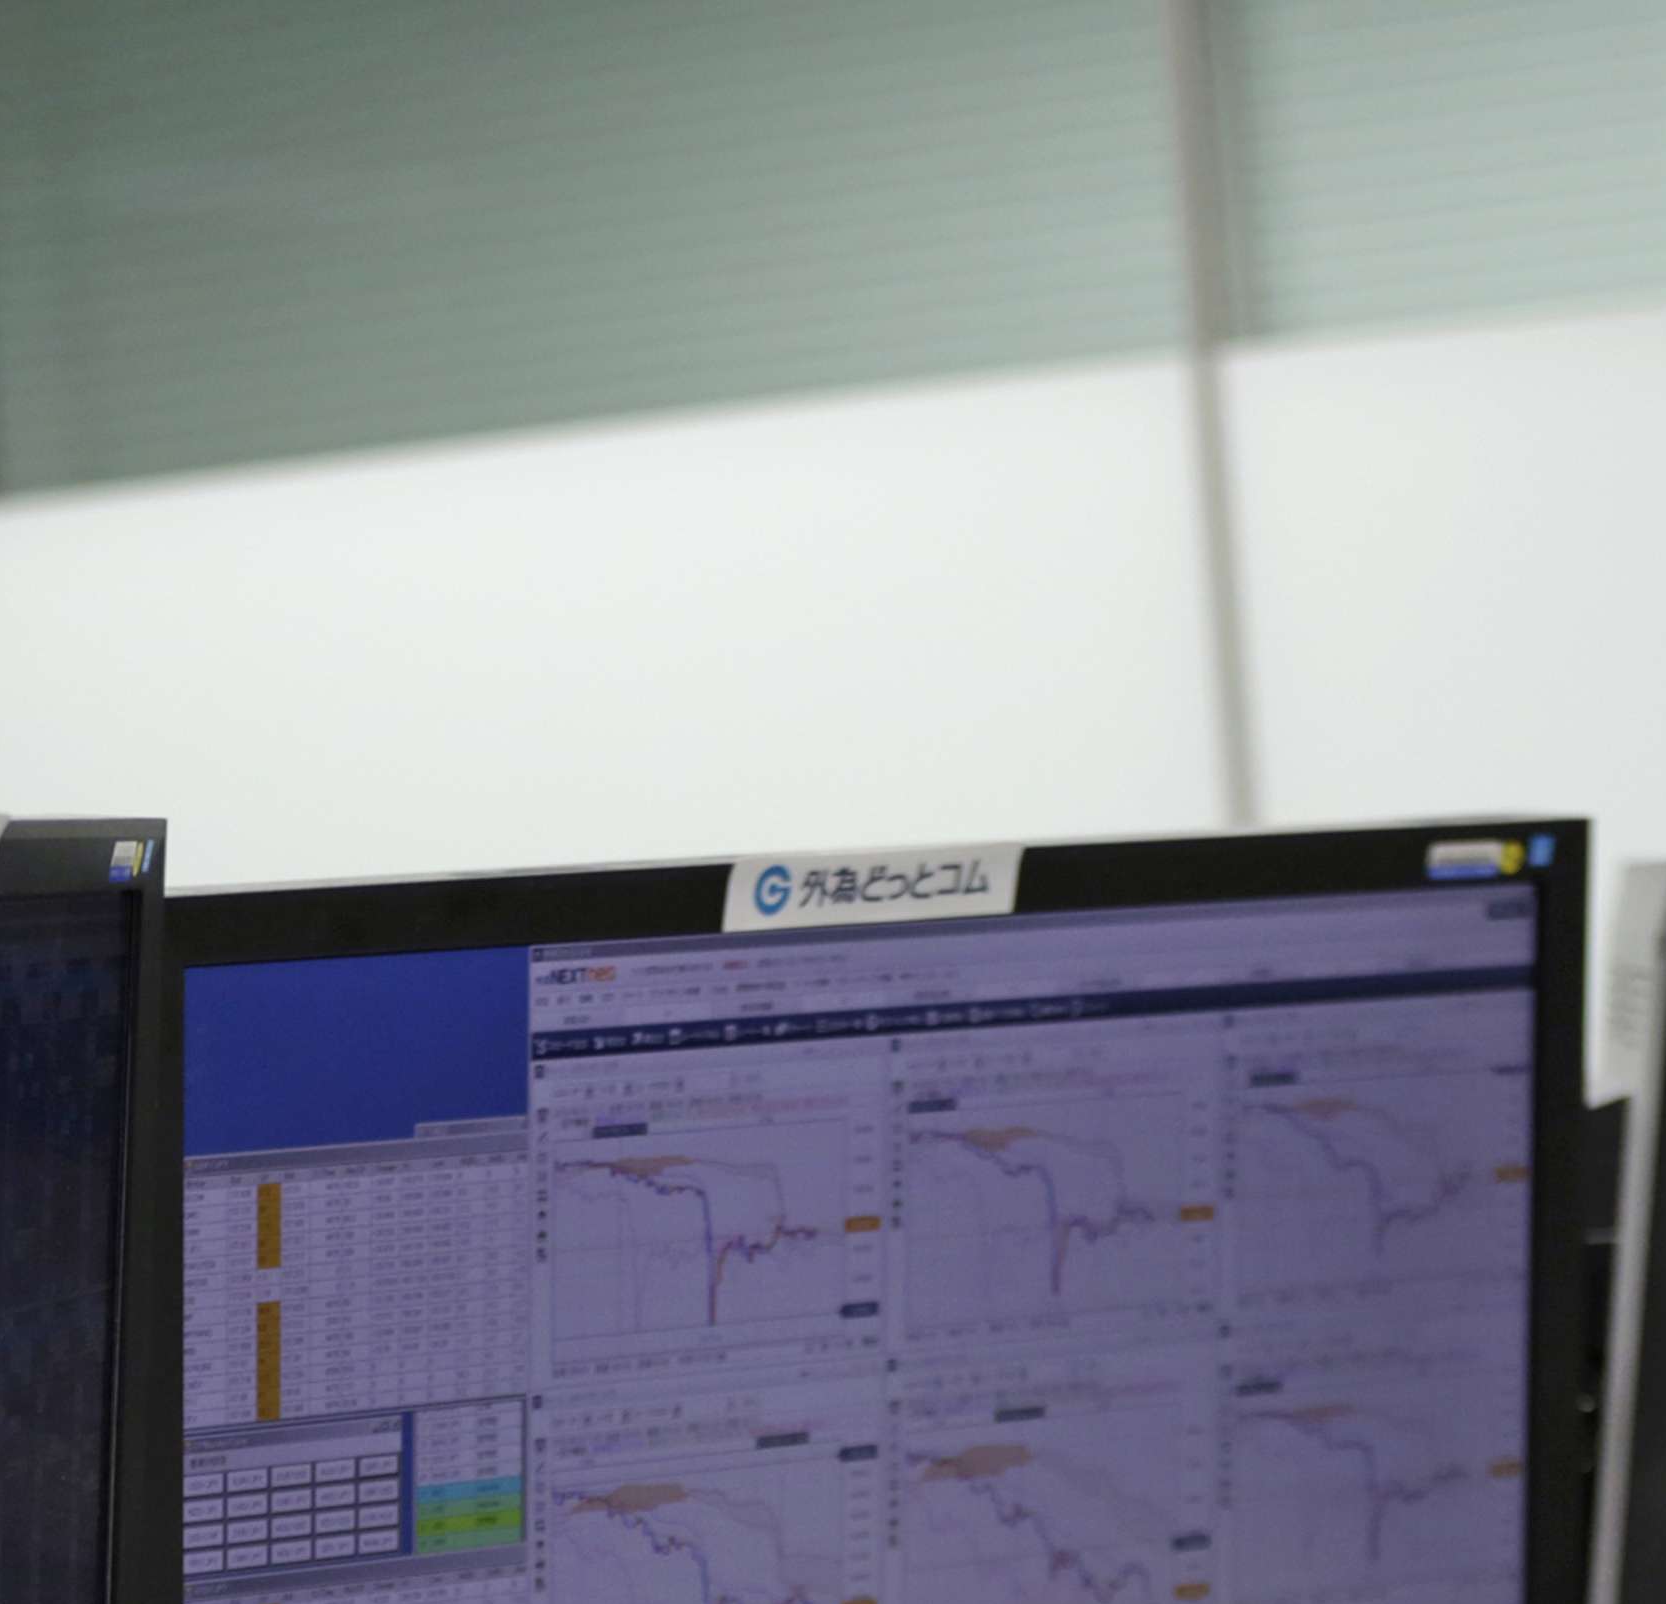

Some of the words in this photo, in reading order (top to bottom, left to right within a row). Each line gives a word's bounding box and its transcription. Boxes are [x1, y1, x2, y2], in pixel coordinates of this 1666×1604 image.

[799, 857, 990, 909] 外為どっとコム
